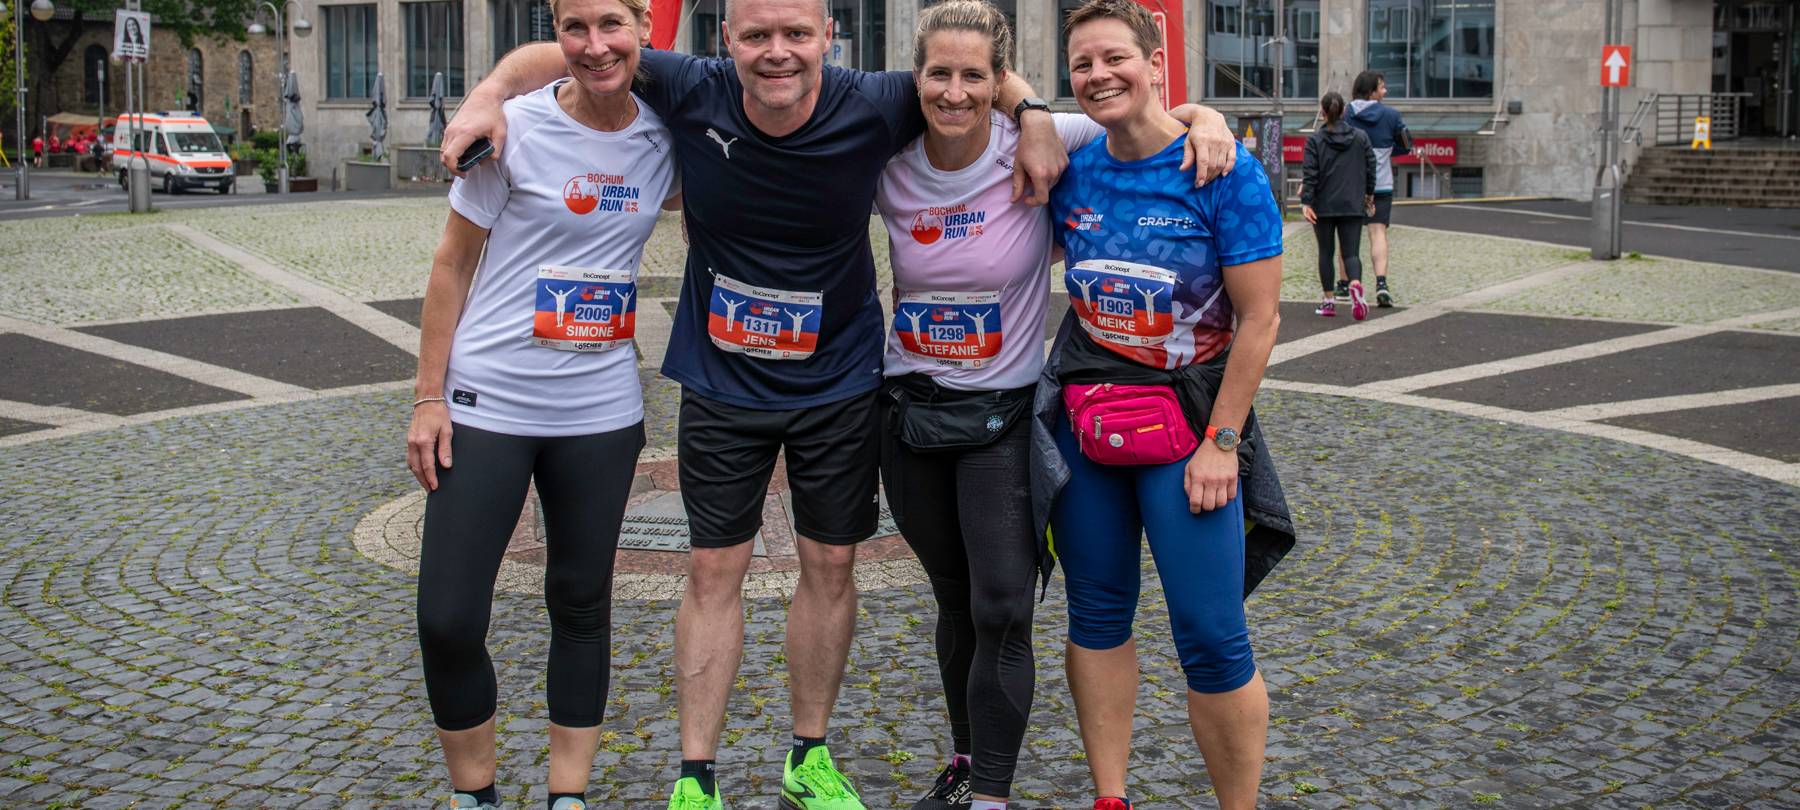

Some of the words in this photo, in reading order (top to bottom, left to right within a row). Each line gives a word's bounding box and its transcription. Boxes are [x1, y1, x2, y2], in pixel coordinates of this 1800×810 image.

[1408, 143, 1454, 159] mplifon
[587, 173, 624, 185] BOCHUM
[601, 185, 640, 199] URBAN
[599, 200, 623, 211] RUN
[929, 204, 967, 216] BOCHUM
[944, 211, 985, 227] URBAN
[1137, 216, 1183, 227] CRAFT
[944, 226, 968, 240] RUN
[575, 306, 611, 322] 2009
[1098, 298, 1133, 316] 1903
[745, 318, 779, 335] 1311
[1096, 315, 1136, 332] MEIKE
[566, 325, 615, 338] SIMONE
[929, 327, 965, 341] 1298
[742, 333, 777, 347] JENS
[920, 343, 979, 356] STEFANIE
